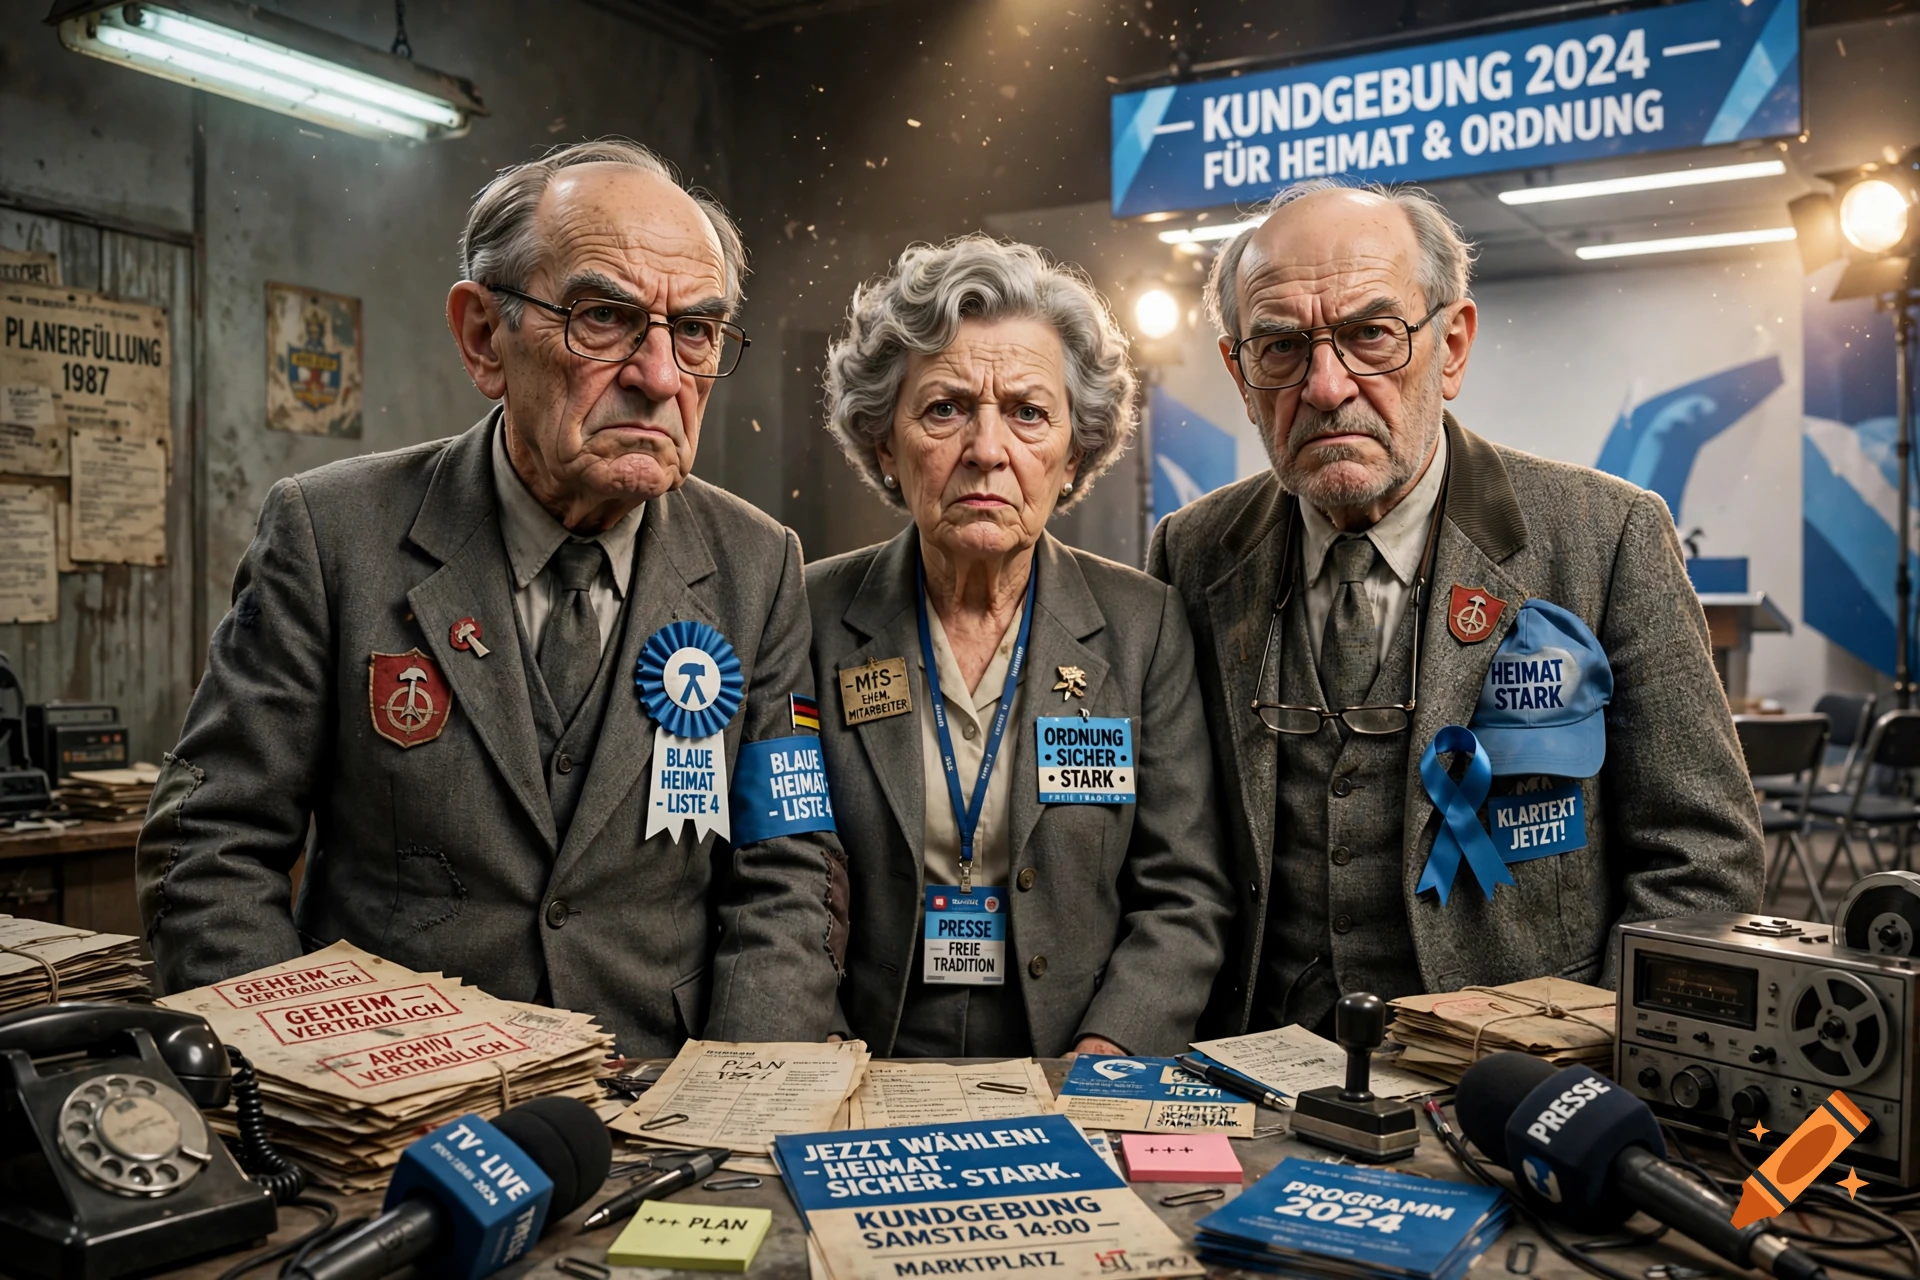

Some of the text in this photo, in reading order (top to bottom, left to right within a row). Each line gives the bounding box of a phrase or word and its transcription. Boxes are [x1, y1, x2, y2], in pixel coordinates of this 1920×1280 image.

[1203, 29, 1650, 141] KUNDGEBUNG 2024
[1204, 89, 1664, 189] FÜR HEIMAT & ORDNUNG
[5, 316, 162, 368] PLANERFÜLLUNG
[62, 363, 110, 397] 1987
[1491, 658, 1563, 685] HEIMAT
[848, 699, 907, 720] MITARBEITER
[862, 690, 890, 704] EHEM.
[1495, 685, 1564, 711] STARK
[1044, 727, 1123, 747] ORDNUNG
[666, 748, 713, 769] BLAUE
[770, 749, 820, 774] BLAUE
[1056, 749, 1116, 767] SICHER
[661, 770, 715, 791] HEIMAT
[1060, 769, 1114, 788] STARK
[667, 793, 707, 814] LISTE
[710, 795, 720, 814] 4
[782, 796, 825, 821] LISTE
[1497, 796, 1576, 828] KLARTEXT
[1510, 819, 1566, 850] JETZT!
[938, 919, 992, 938] PRESSE
[949, 942, 981, 956] FREIE
[933, 957, 995, 972] TRADITION
[235, 969, 329, 995] GEHEIM
[239, 974, 362, 1004] VERTRAULICH
[284, 995, 397, 1025] GEHEIM
[287, 1002, 444, 1039] VERTRAULICH
[357, 1040, 511, 1082] VERTRAULICH
[721, 1060, 786, 1070] PLAN
[1527, 1077, 1612, 1145] PRESSE
[803, 1126, 1051, 1164] JEZZT WÄHLEN!
[824, 1154, 952, 1181] HEIMAT.
[830, 1162, 1081, 1199] SICHER. STARK.
[853, 1195, 1101, 1231] KUNDGEBUNG
[1282, 1180, 1456, 1221] PROGRAMM
[688, 1216, 749, 1231] PLAN
[1274, 1195, 1405, 1234] 2024
[866, 1217, 1091, 1250] SAMSTAG 14:00
[894, 1250, 1064, 1278] MARKTPLATZ
